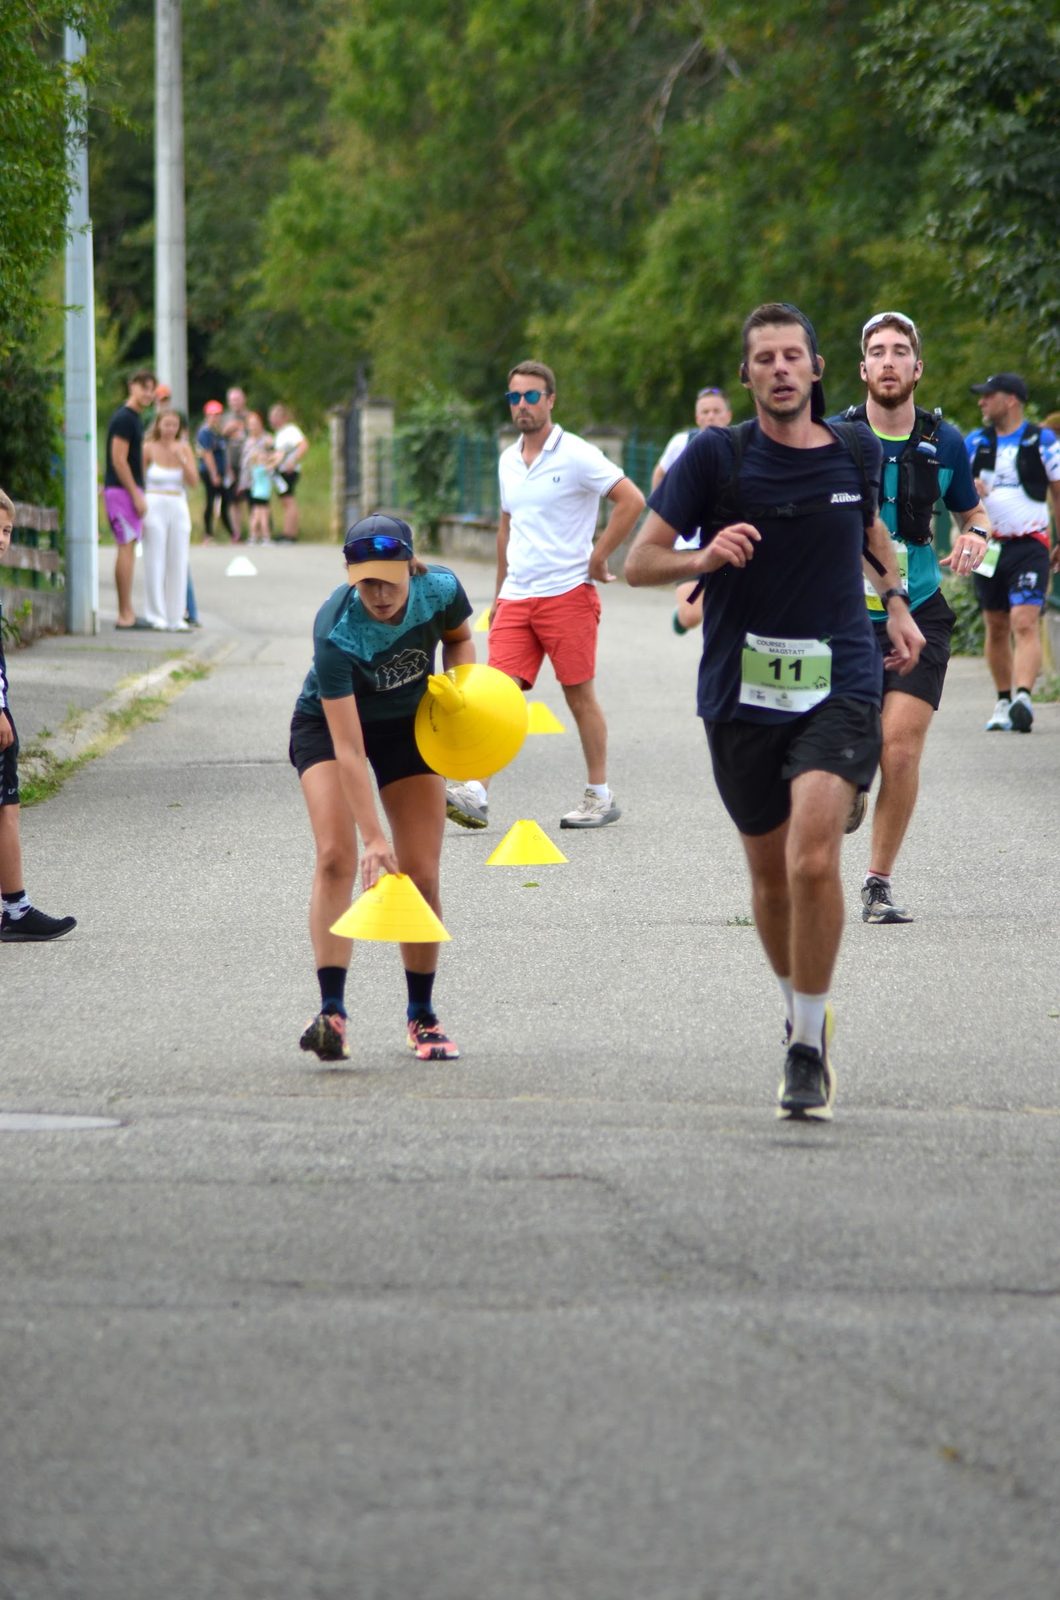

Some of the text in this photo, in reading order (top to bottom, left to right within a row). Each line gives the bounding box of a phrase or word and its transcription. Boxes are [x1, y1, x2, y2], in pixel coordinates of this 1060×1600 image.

[756, 639, 786, 648] COURSES
[769, 648, 805, 656] MAGSTATT
[768, 657, 803, 681] 11
